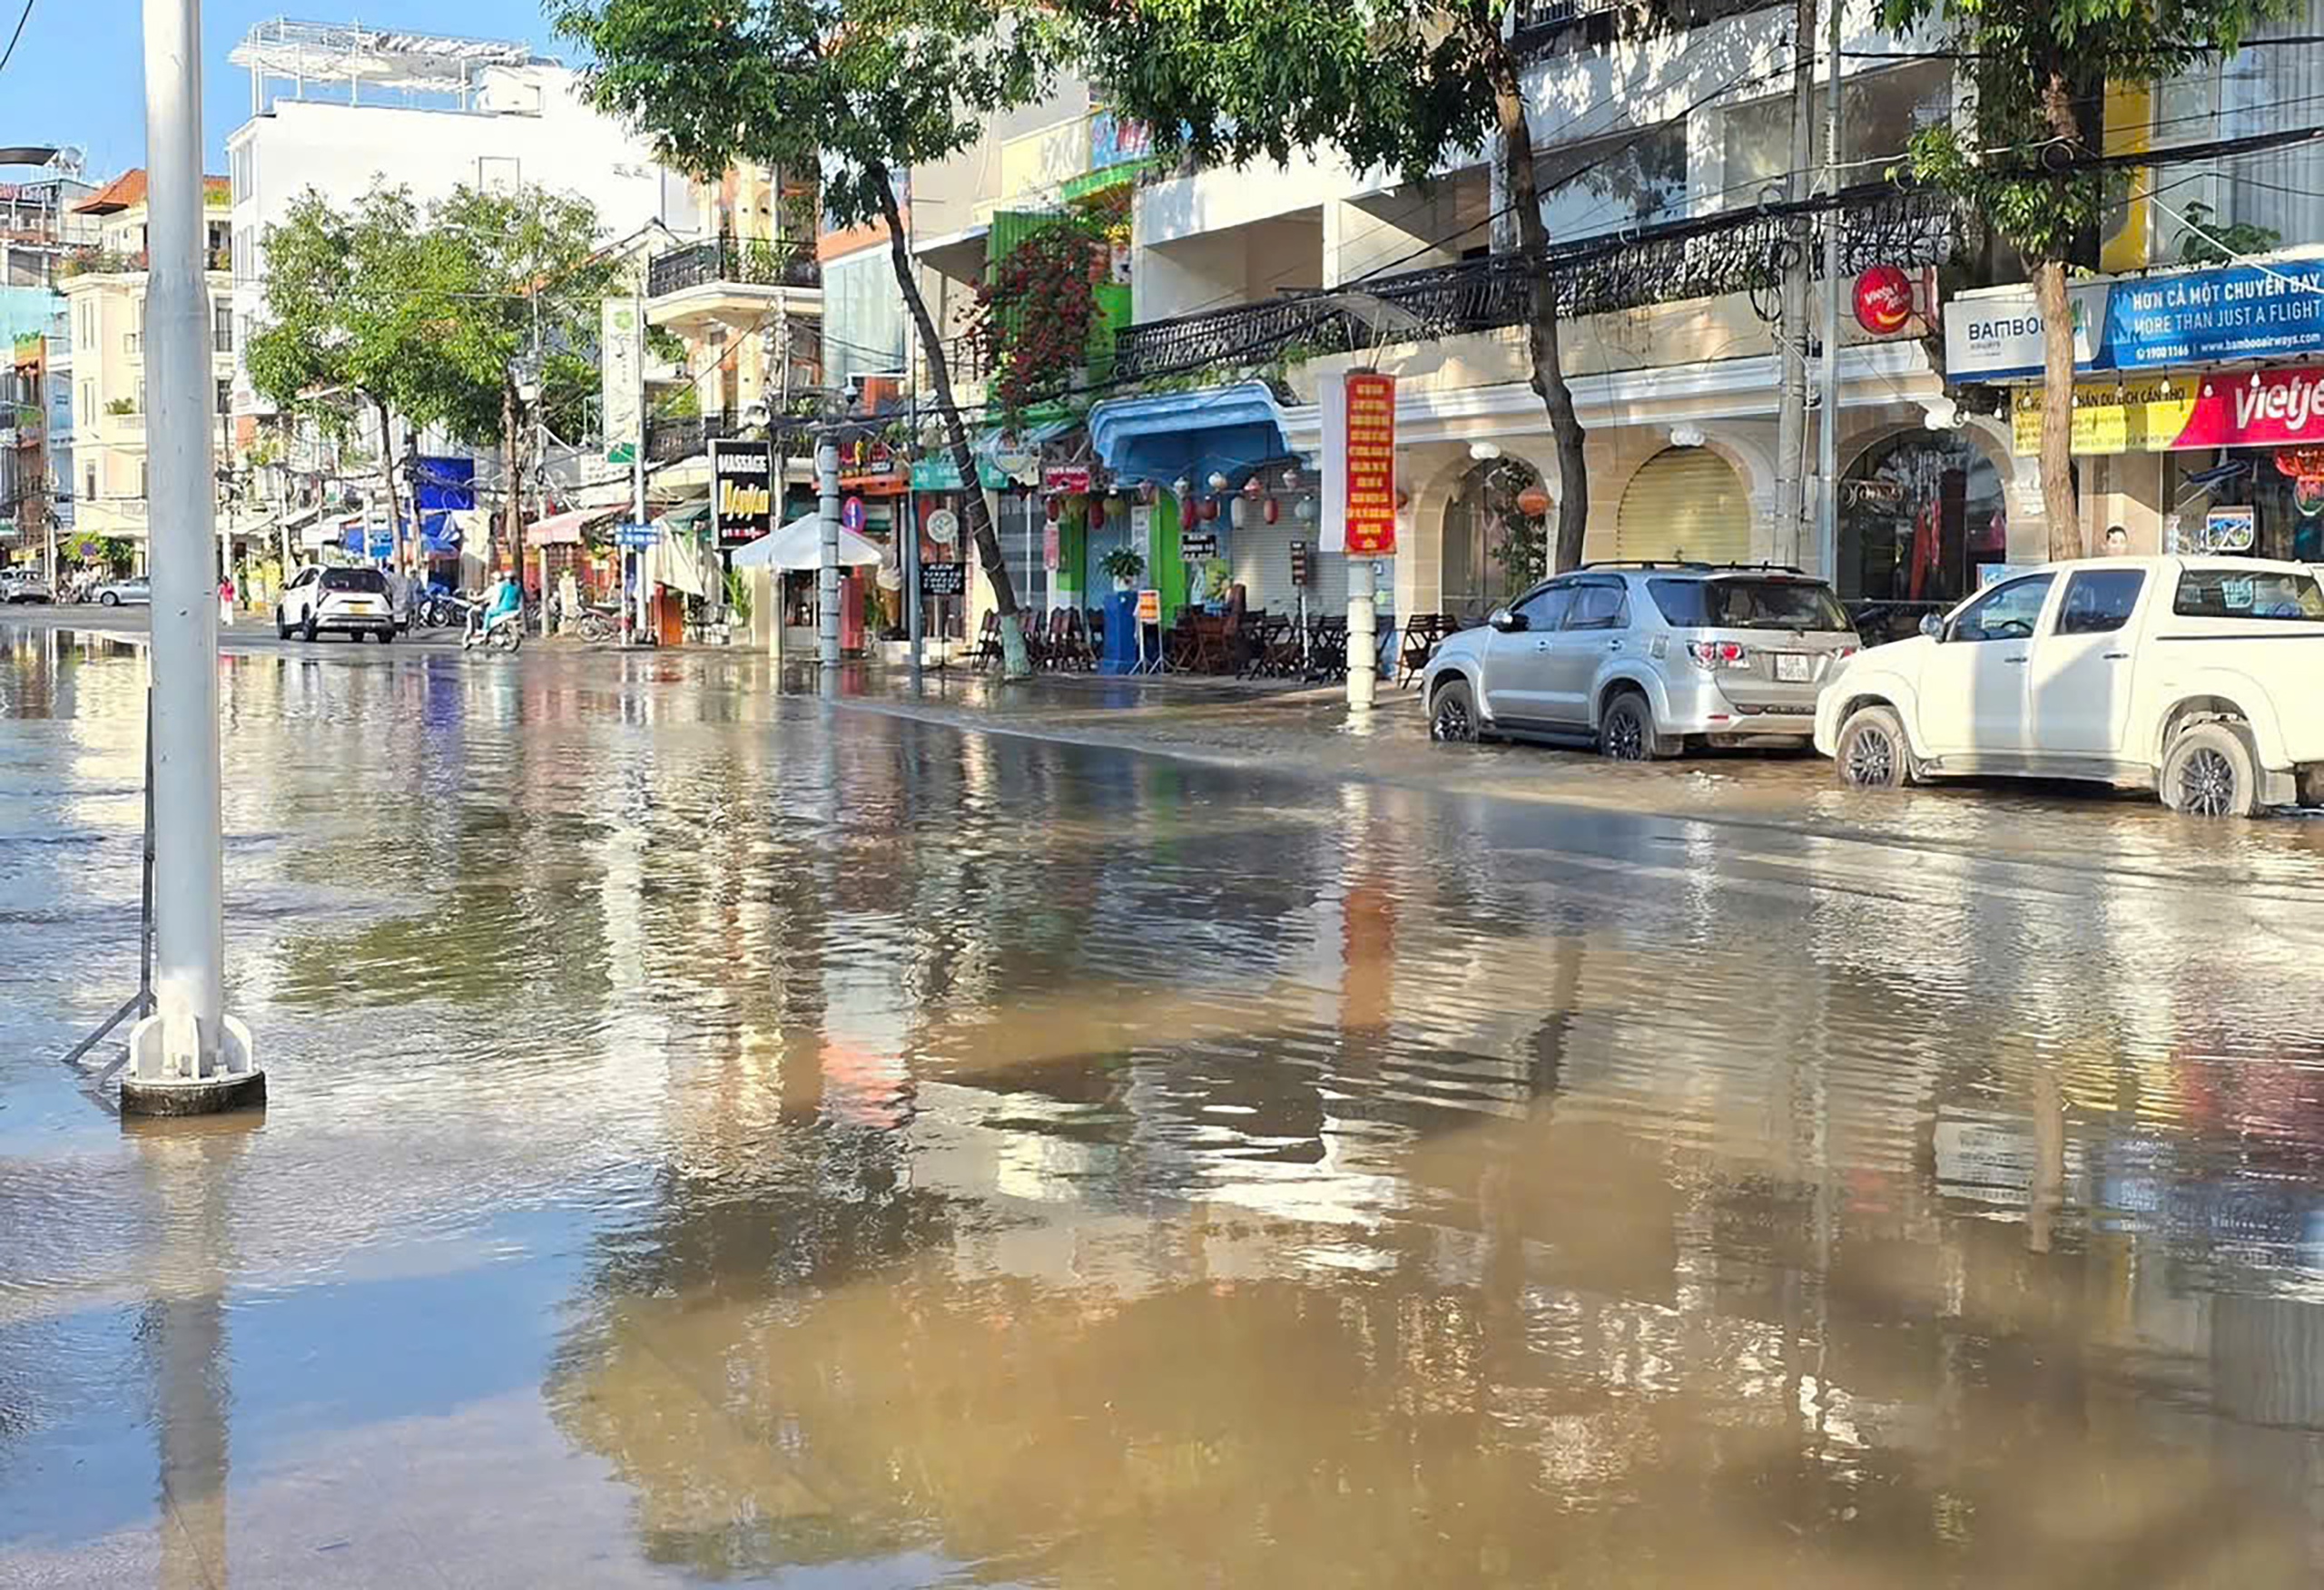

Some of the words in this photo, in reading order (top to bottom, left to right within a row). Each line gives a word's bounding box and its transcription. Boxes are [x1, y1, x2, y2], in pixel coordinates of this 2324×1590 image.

[2134, 314, 2171, 336] MORE
[2177, 311, 2212, 330] THAN
[2218, 307, 2251, 327] JUST
[2255, 306, 2266, 323] A
[2270, 299, 2321, 321] FLIGHT
[1969, 318, 2044, 340] BAMBO
[718, 455, 767, 472] MASSAGE
